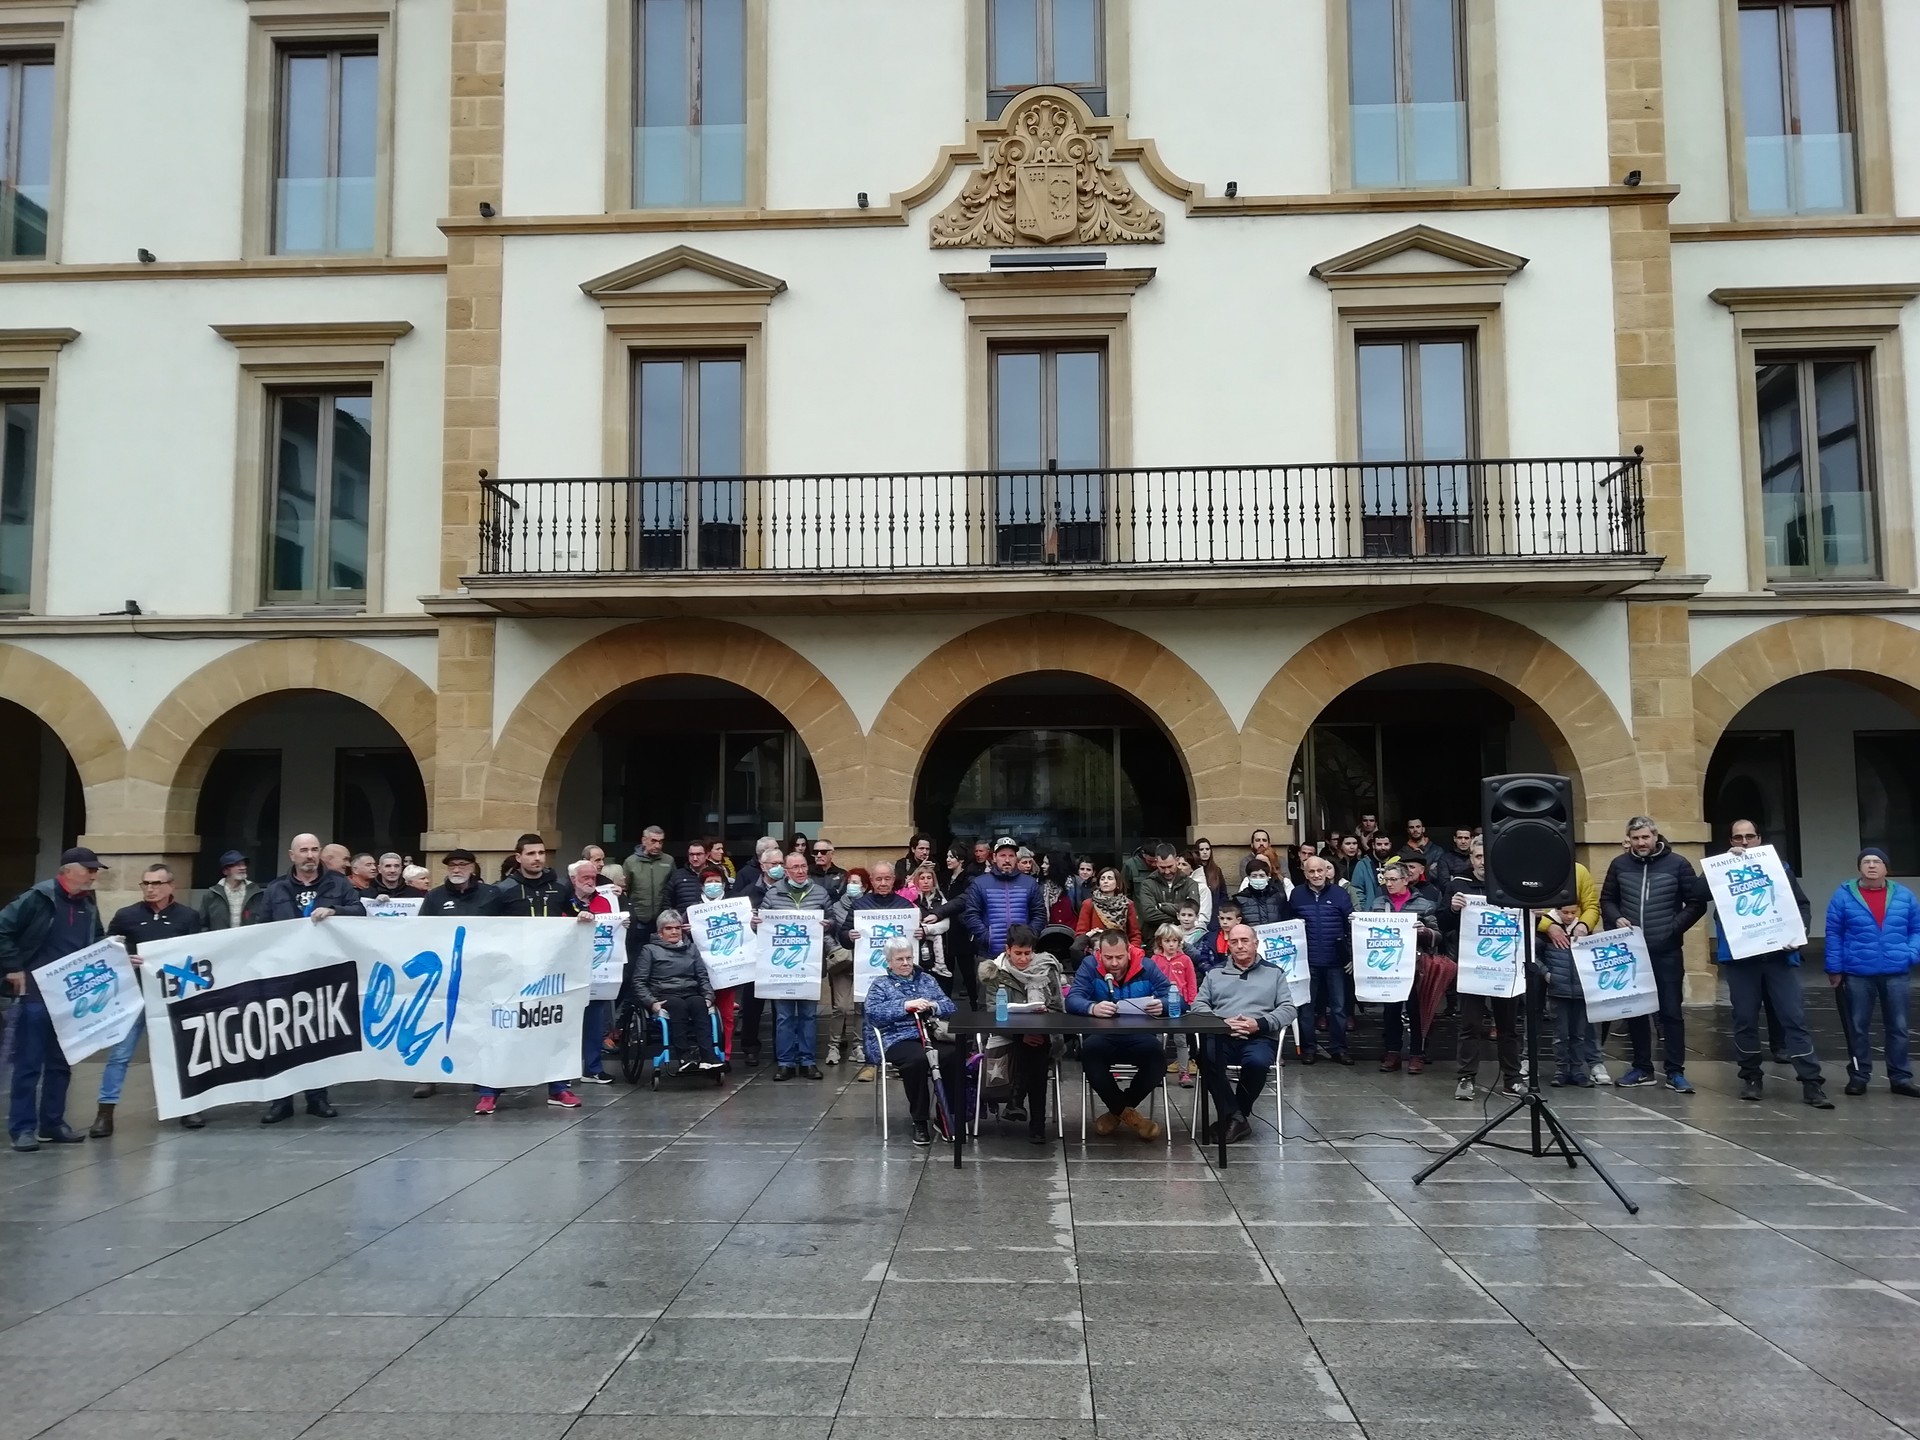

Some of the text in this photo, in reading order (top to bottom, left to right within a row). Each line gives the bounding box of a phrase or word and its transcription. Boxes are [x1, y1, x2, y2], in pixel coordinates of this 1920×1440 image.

[1710, 852, 1767, 869] MANIFESTAZIOA
[1731, 877, 1770, 895] ZIGORRIK
[694, 902, 743, 915] MANIFESTAZIOA
[708, 923, 741, 938] ZIGORRIK
[1258, 925, 1298, 935] ANIFESTAZIOA
[1368, 940, 1401, 948] ZIGORRIK
[1579, 931, 1634, 947] MANIFESTAZIOA
[1265, 947, 1296, 959] ZIGORRIK
[1594, 954, 1632, 969] ZIGORRIK
[68, 971, 114, 999] ZIGORRIK
[181, 925, 467, 1078] ZIGORRIK ez!
